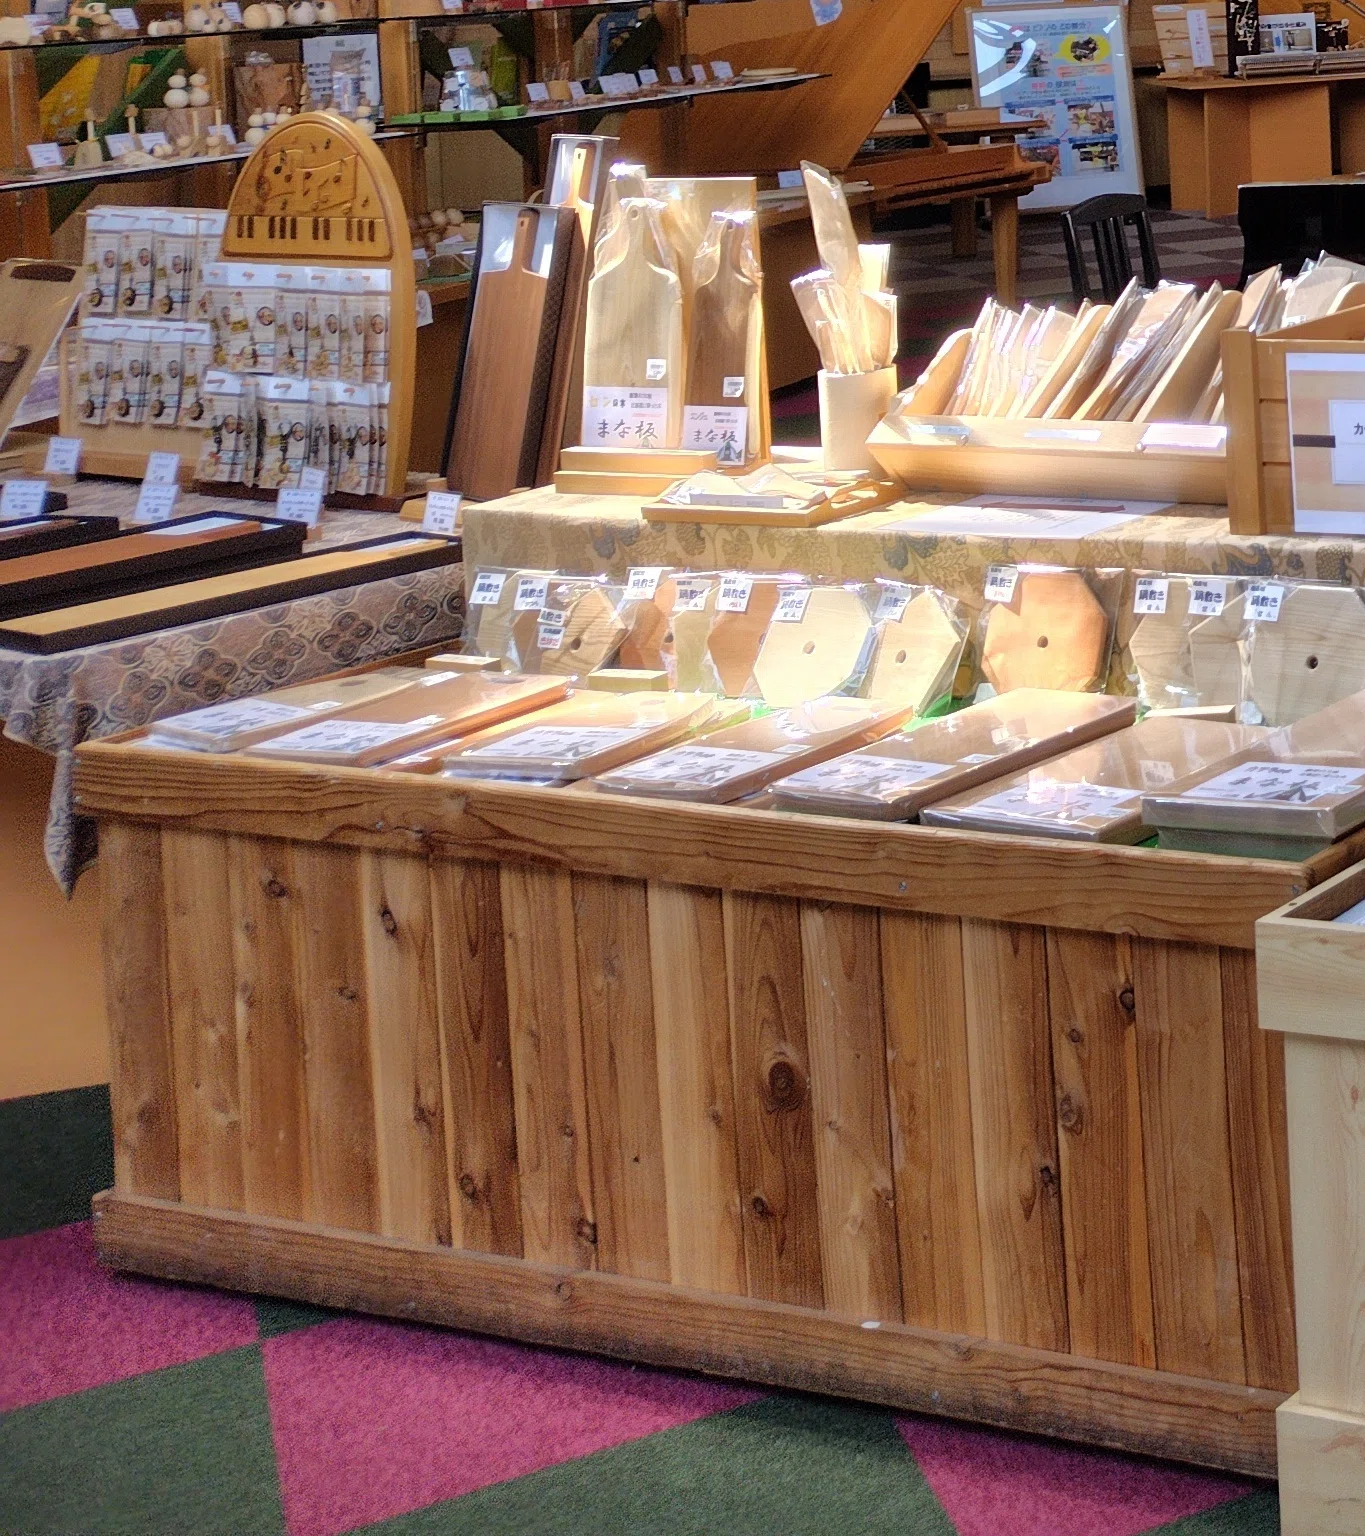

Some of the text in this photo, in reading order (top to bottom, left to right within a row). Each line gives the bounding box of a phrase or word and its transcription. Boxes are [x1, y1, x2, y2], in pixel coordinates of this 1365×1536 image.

[596, 418, 659, 440] まな板
[692, 428, 739, 444] まな板
[1138, 589, 1165, 601] 鍋敷き
[1194, 590, 1223, 603] 鍋敷き
[1250, 594, 1279, 608] 鍋敷き
